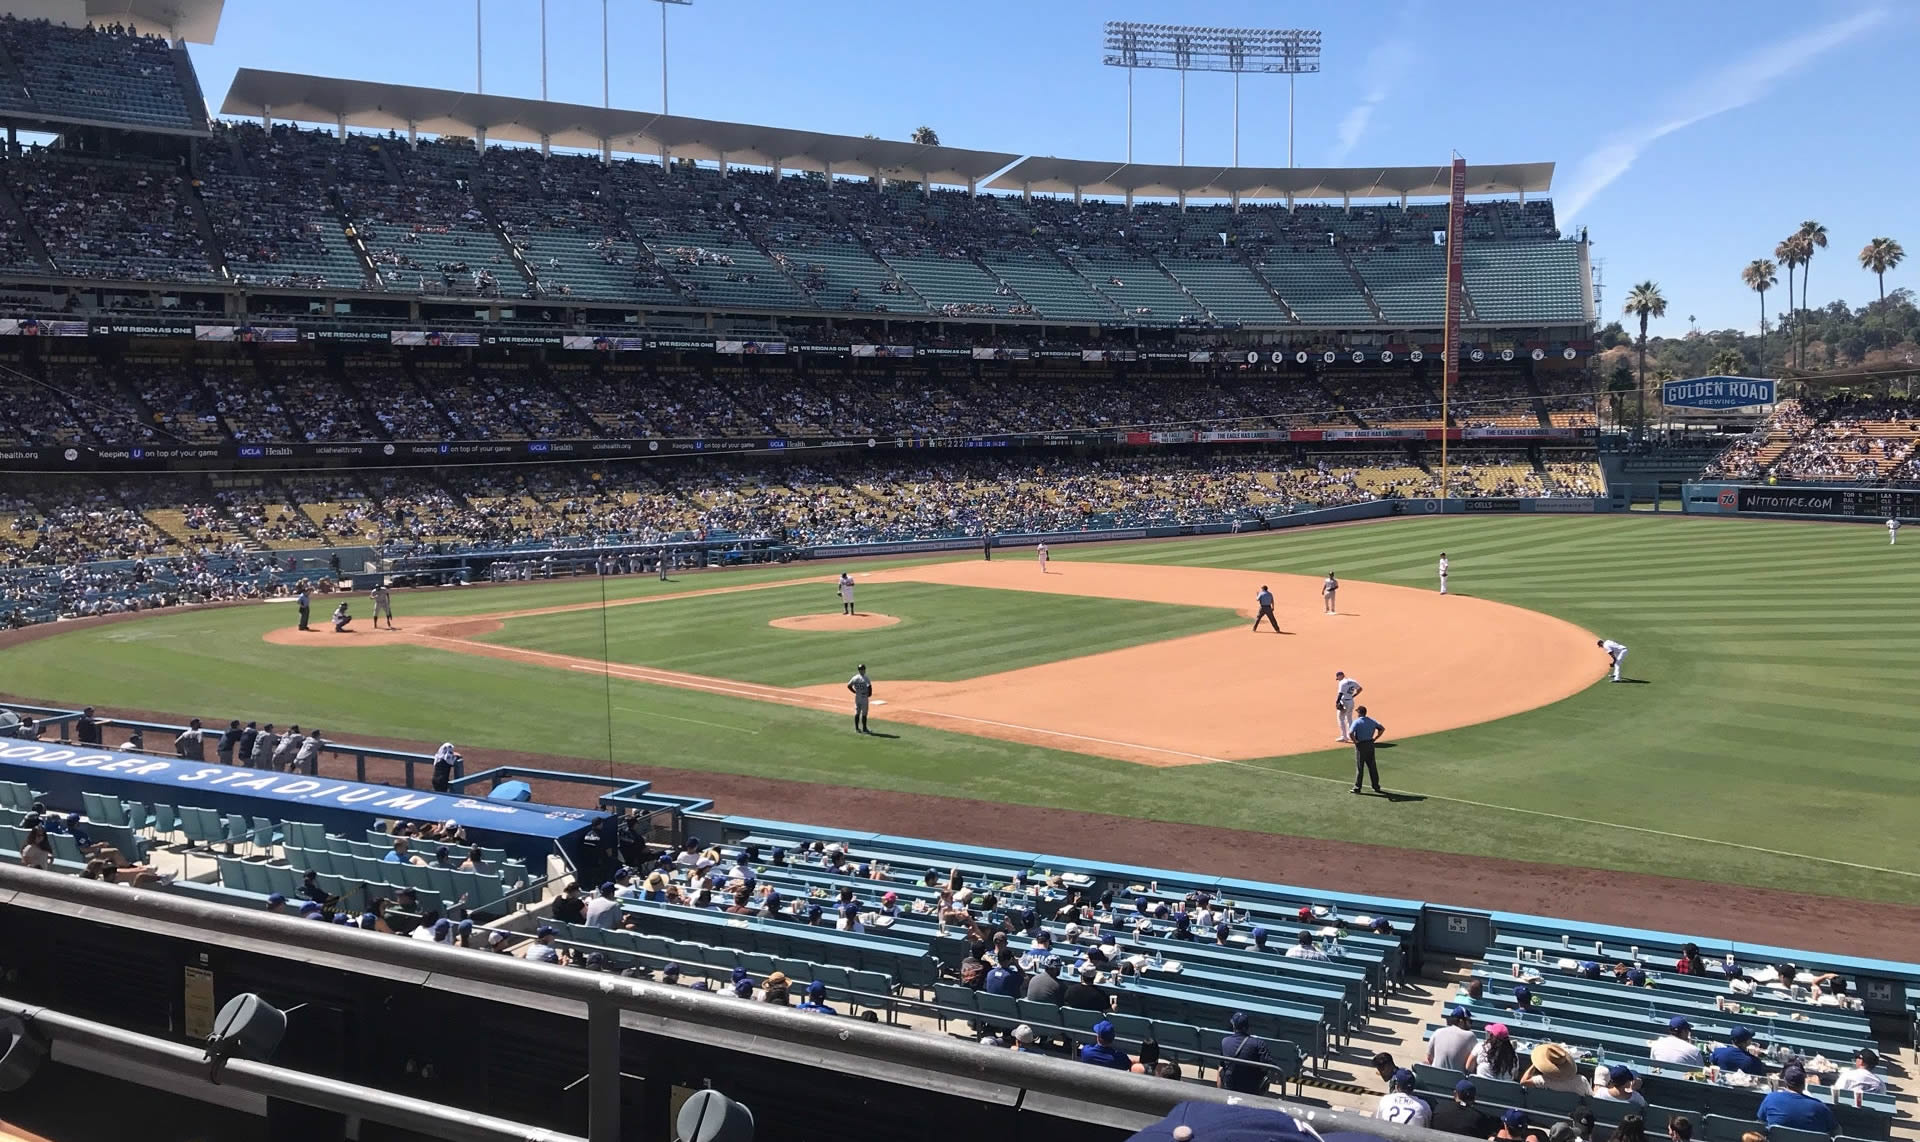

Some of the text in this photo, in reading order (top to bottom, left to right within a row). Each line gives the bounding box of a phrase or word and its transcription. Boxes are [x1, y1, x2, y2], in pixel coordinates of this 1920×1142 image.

[1451, 215, 1464, 265] Emirates
[1448, 325, 1459, 374] Emirates
[1668, 382, 1768, 402] GOLDEN ROAD
[265, 448, 293, 456] Health
[412, 446, 438, 454] Keeping
[460, 446, 471, 454] top
[550, 443, 574, 451] Health
[712, 442, 721, 450] top
[99, 451, 129, 459] Keeping
[133, 450, 140, 458] U
[156, 450, 169, 458] top
[180, 450, 198, 458] your
[1721, 495, 1735, 505] 76
[1746, 495, 1833, 510] NITTOTIRE.COM
[0, 742, 436, 811] ODGER STADIUM
[1390, 1106, 1416, 1125] 27
